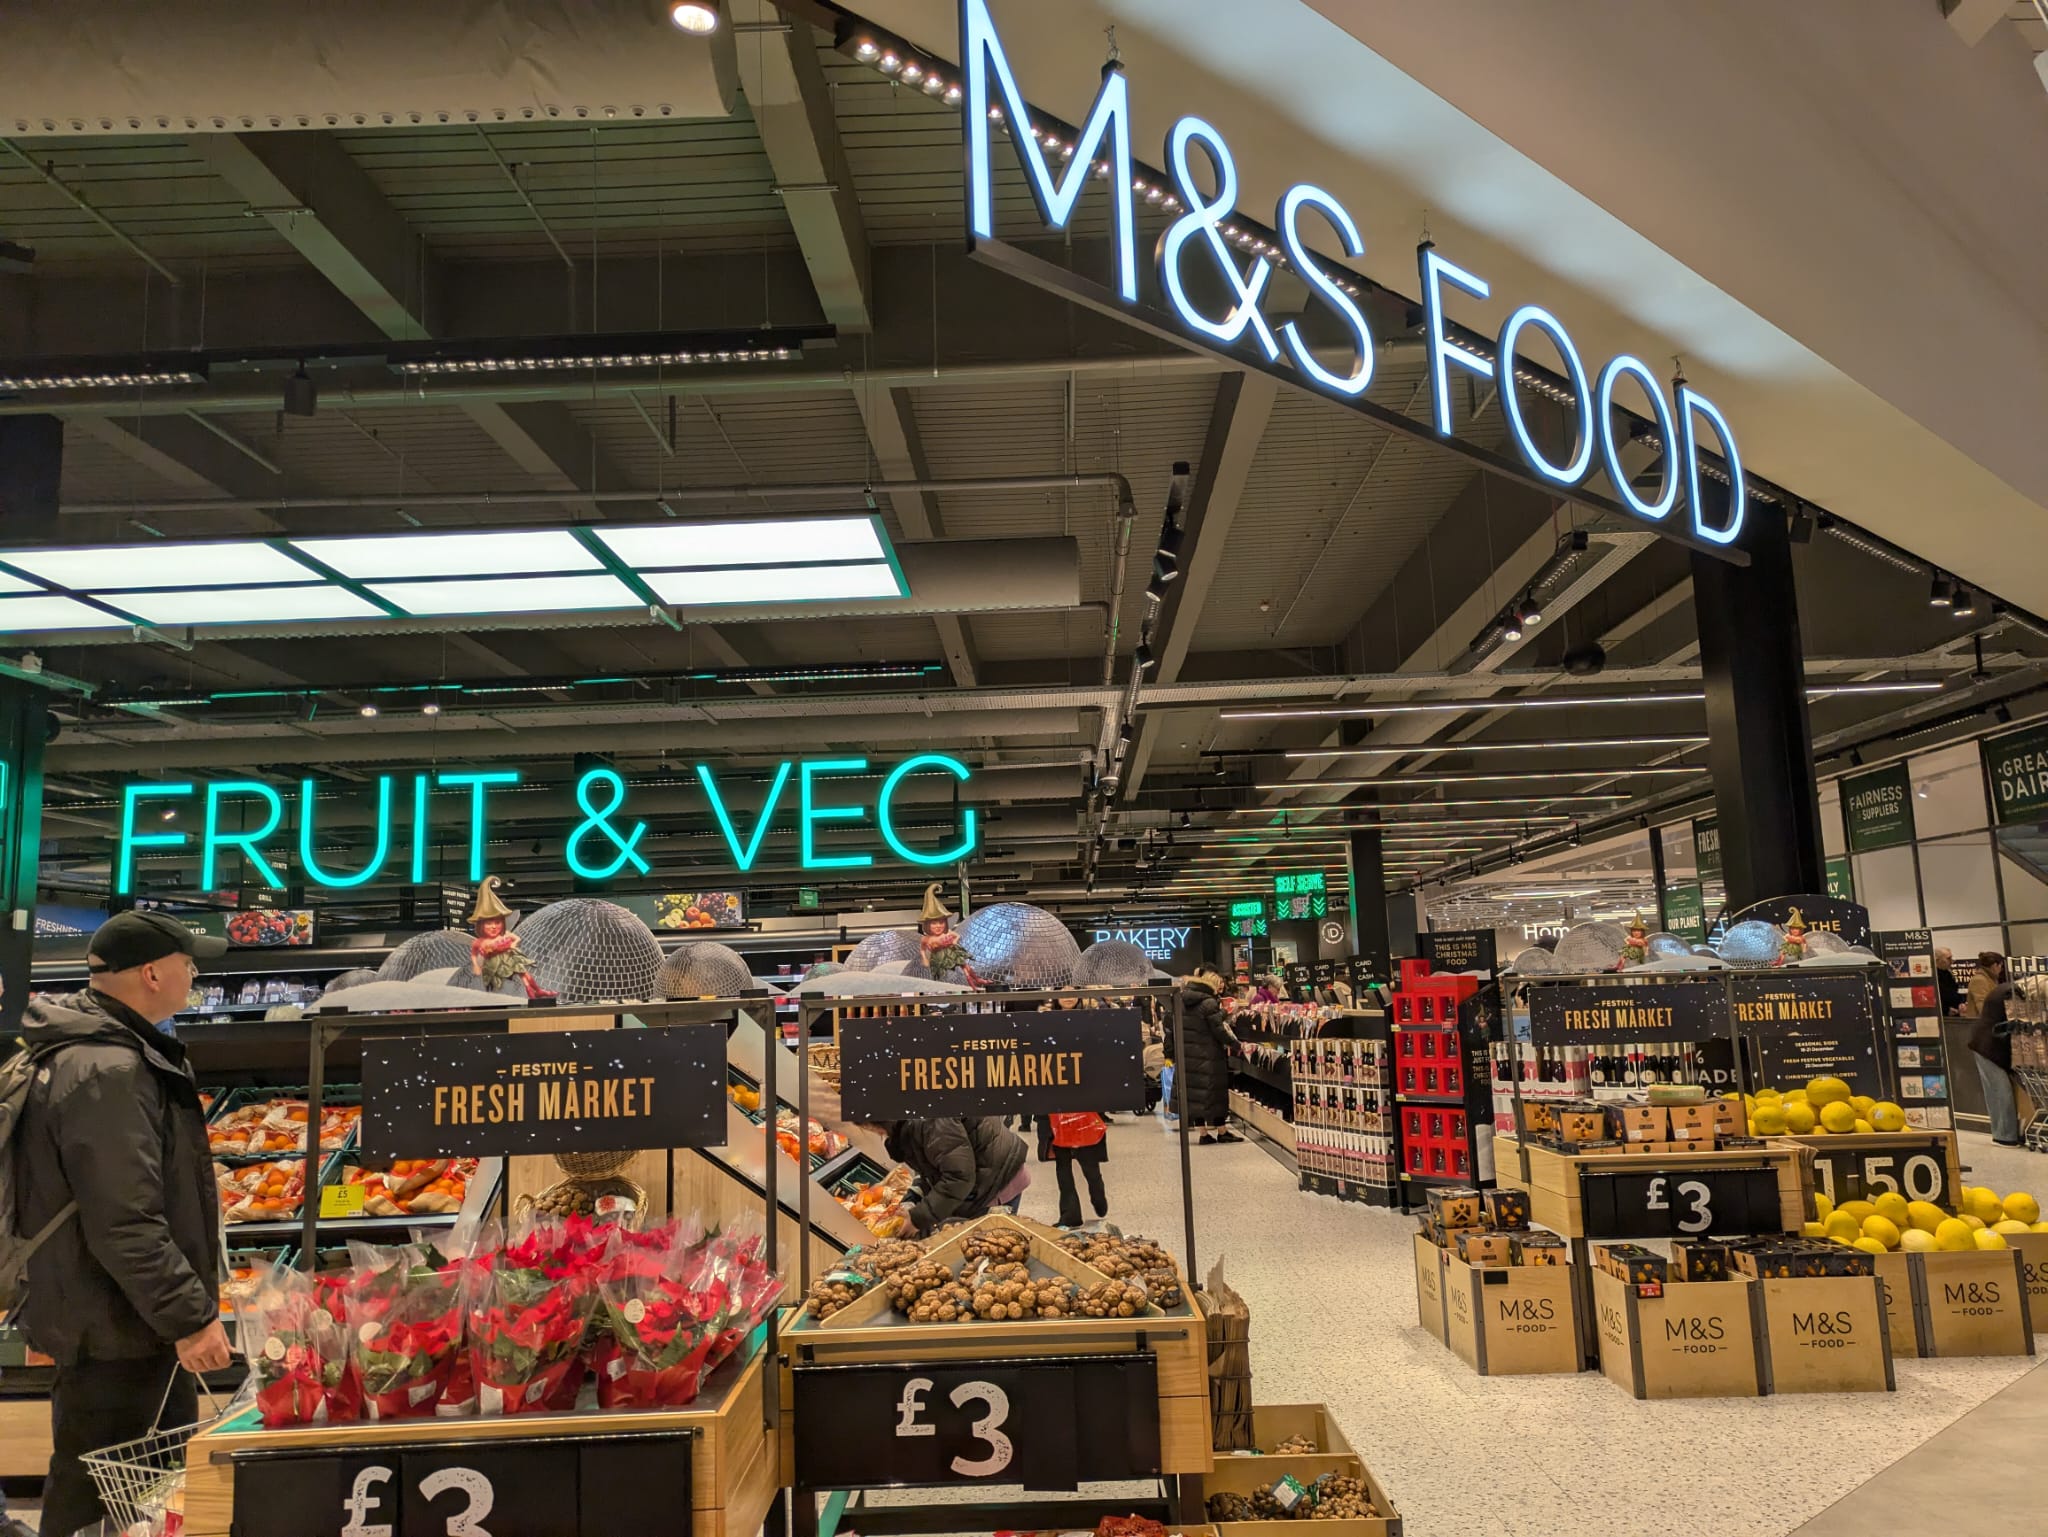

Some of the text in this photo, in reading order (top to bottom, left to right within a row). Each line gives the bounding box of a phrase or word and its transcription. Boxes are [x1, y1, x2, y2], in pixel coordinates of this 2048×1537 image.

[961, 0, 1746, 545] M&S FOOD
[2002, 750, 2048, 777] GREA
[2001, 771, 2048, 802] DAIR
[1849, 785, 1904, 812] FAIRNESS
[1862, 802, 1899, 820] SUPPLIERS
[117, 754, 977, 895] FRUIT & VEG
[1524, 923, 1570, 940] Hom
[1668, 915, 1700, 930] OUR PLANET
[1808, 920, 1841, 932] THE
[1096, 927, 1190, 949] BAKERY
[1905, 931, 1929, 940] M&S
[1435, 950, 1477, 958] CHRISTMAS
[1446, 958, 1467, 966] FOOD
[1952, 968, 1976, 976] STIVE
[1602, 999, 1635, 1007] FESTIVE
[1778, 1000, 1832, 1020] MARKET
[1565, 1007, 1673, 1030] FRESH MARKET
[963, 1038, 1018, 1051] FESTIVE
[512, 1062, 578, 1077] FESTIVE
[901, 1052, 1083, 1091] FRESH MARKET
[434, 1077, 655, 1125] FRESH MARKET
[338, 1190, 348, 1198] £5
[1647, 1177, 1712, 1232] £3
[1421, 1266, 1437, 1291] M&S
[2024, 1262, 2048, 1283] &S
[1450, 1285, 1467, 1313] M&S
[1944, 1281, 2000, 1304] M&S
[1500, 1298, 1555, 1321] M&S
[1600, 1303, 1623, 1335] M&S
[1962, 1307, 1993, 1316] FOOD
[1516, 1324, 1547, 1333] FOOD
[1665, 1316, 1725, 1341] M&S
[1792, 1311, 1853, 1335] M&S
[1683, 1344, 1717, 1354] FOOD
[1811, 1339, 1845, 1348] FOOD
[895, 1377, 1014, 1477] £3
[342, 1465, 494, 1537] £3
